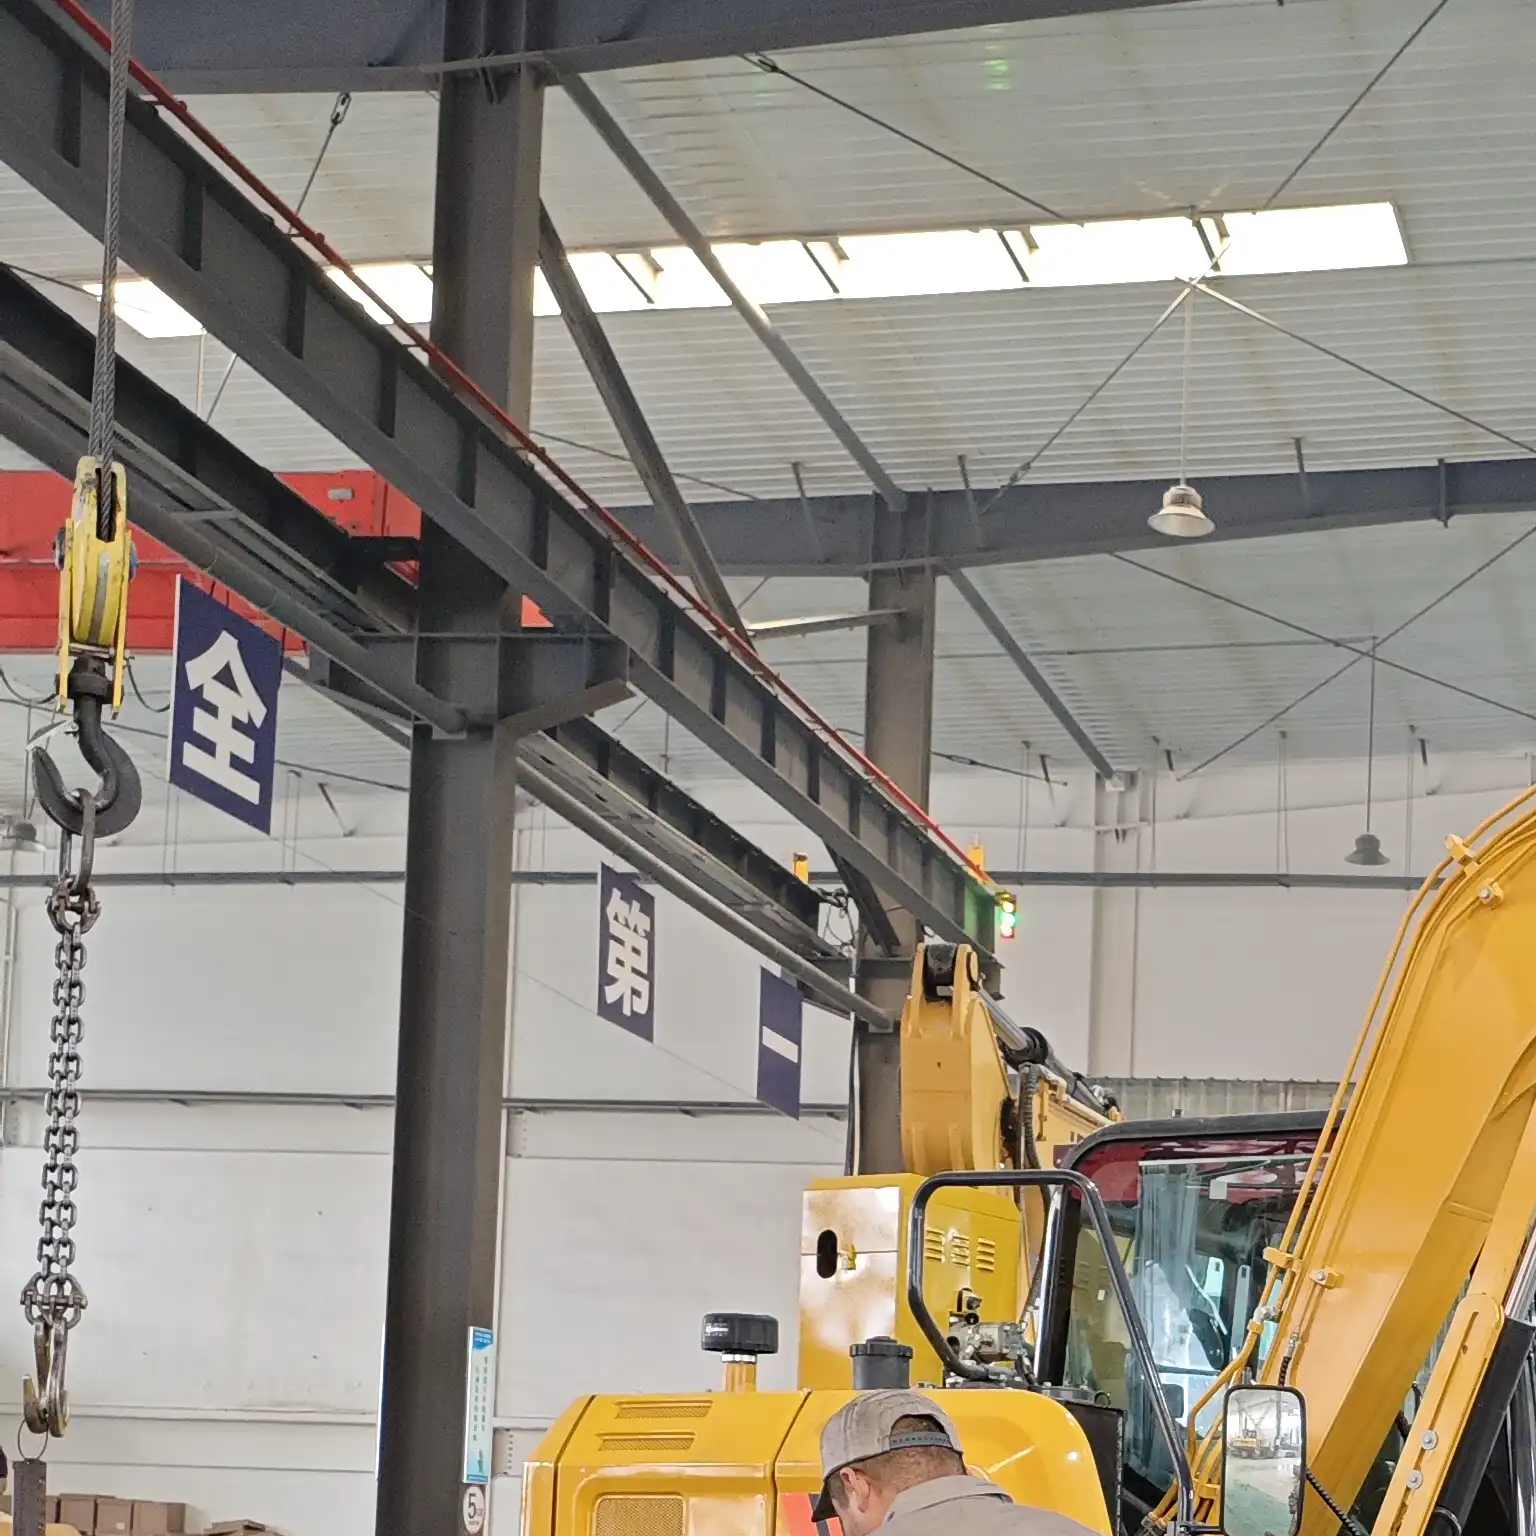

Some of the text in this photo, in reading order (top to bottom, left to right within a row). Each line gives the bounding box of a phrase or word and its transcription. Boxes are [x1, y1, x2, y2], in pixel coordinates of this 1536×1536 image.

[181, 630, 800, 1064] 全 第 一
